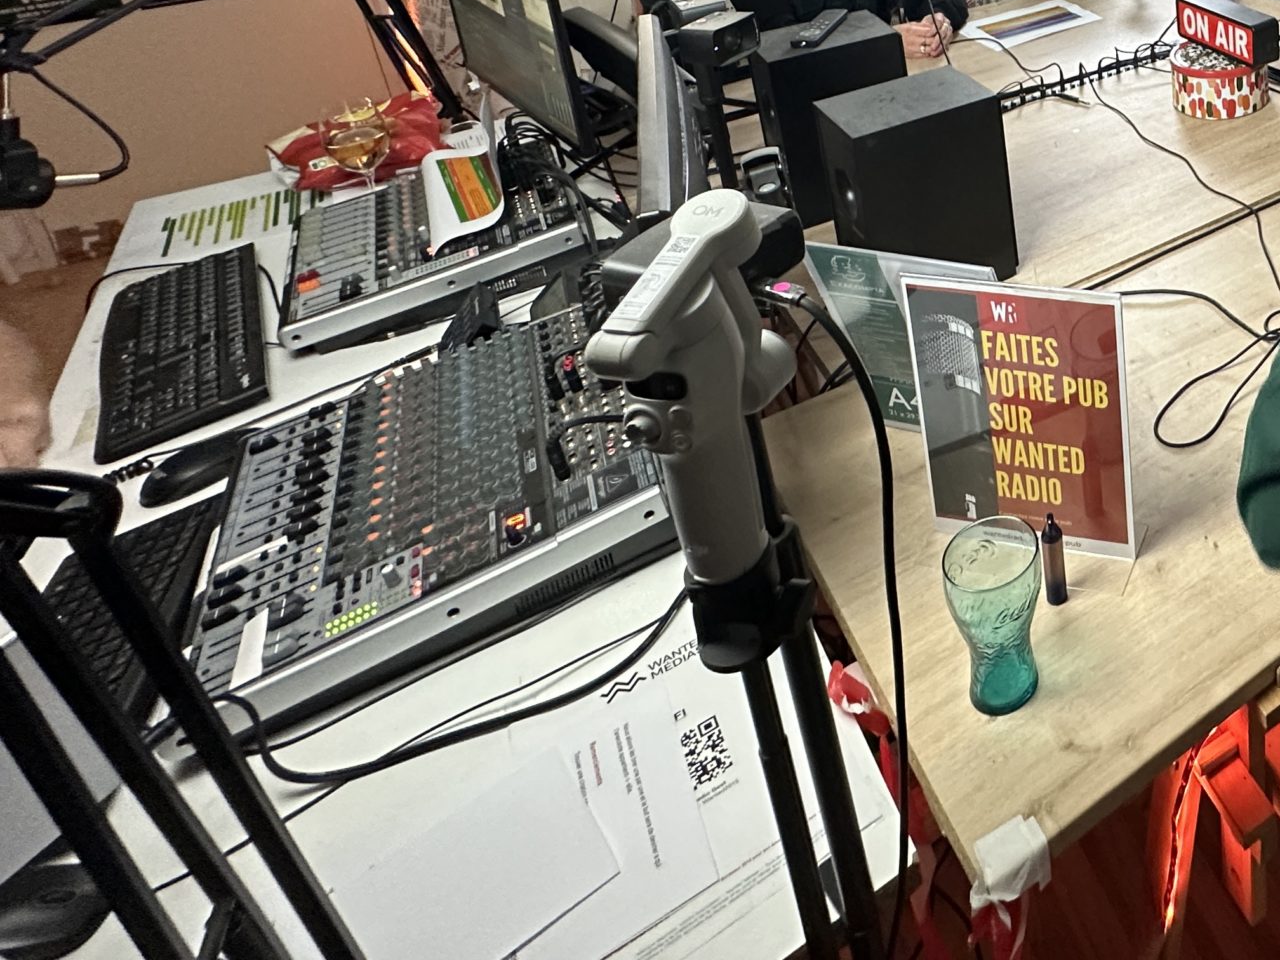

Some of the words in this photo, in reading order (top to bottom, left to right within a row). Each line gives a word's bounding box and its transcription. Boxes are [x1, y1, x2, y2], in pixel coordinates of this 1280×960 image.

[1183, 7, 1210, 43] ON
[1215, 20, 1249, 59] AIR
[980, 330, 1059, 368] FAITES
[984, 366, 1057, 403] VOTRE
[1063, 376, 1109, 409] PUB
[988, 402, 1033, 435] SUR
[991, 436, 1085, 475] WANTED
[996, 470, 1063, 506] RADIO
[648, 639, 699, 670] WANTE
